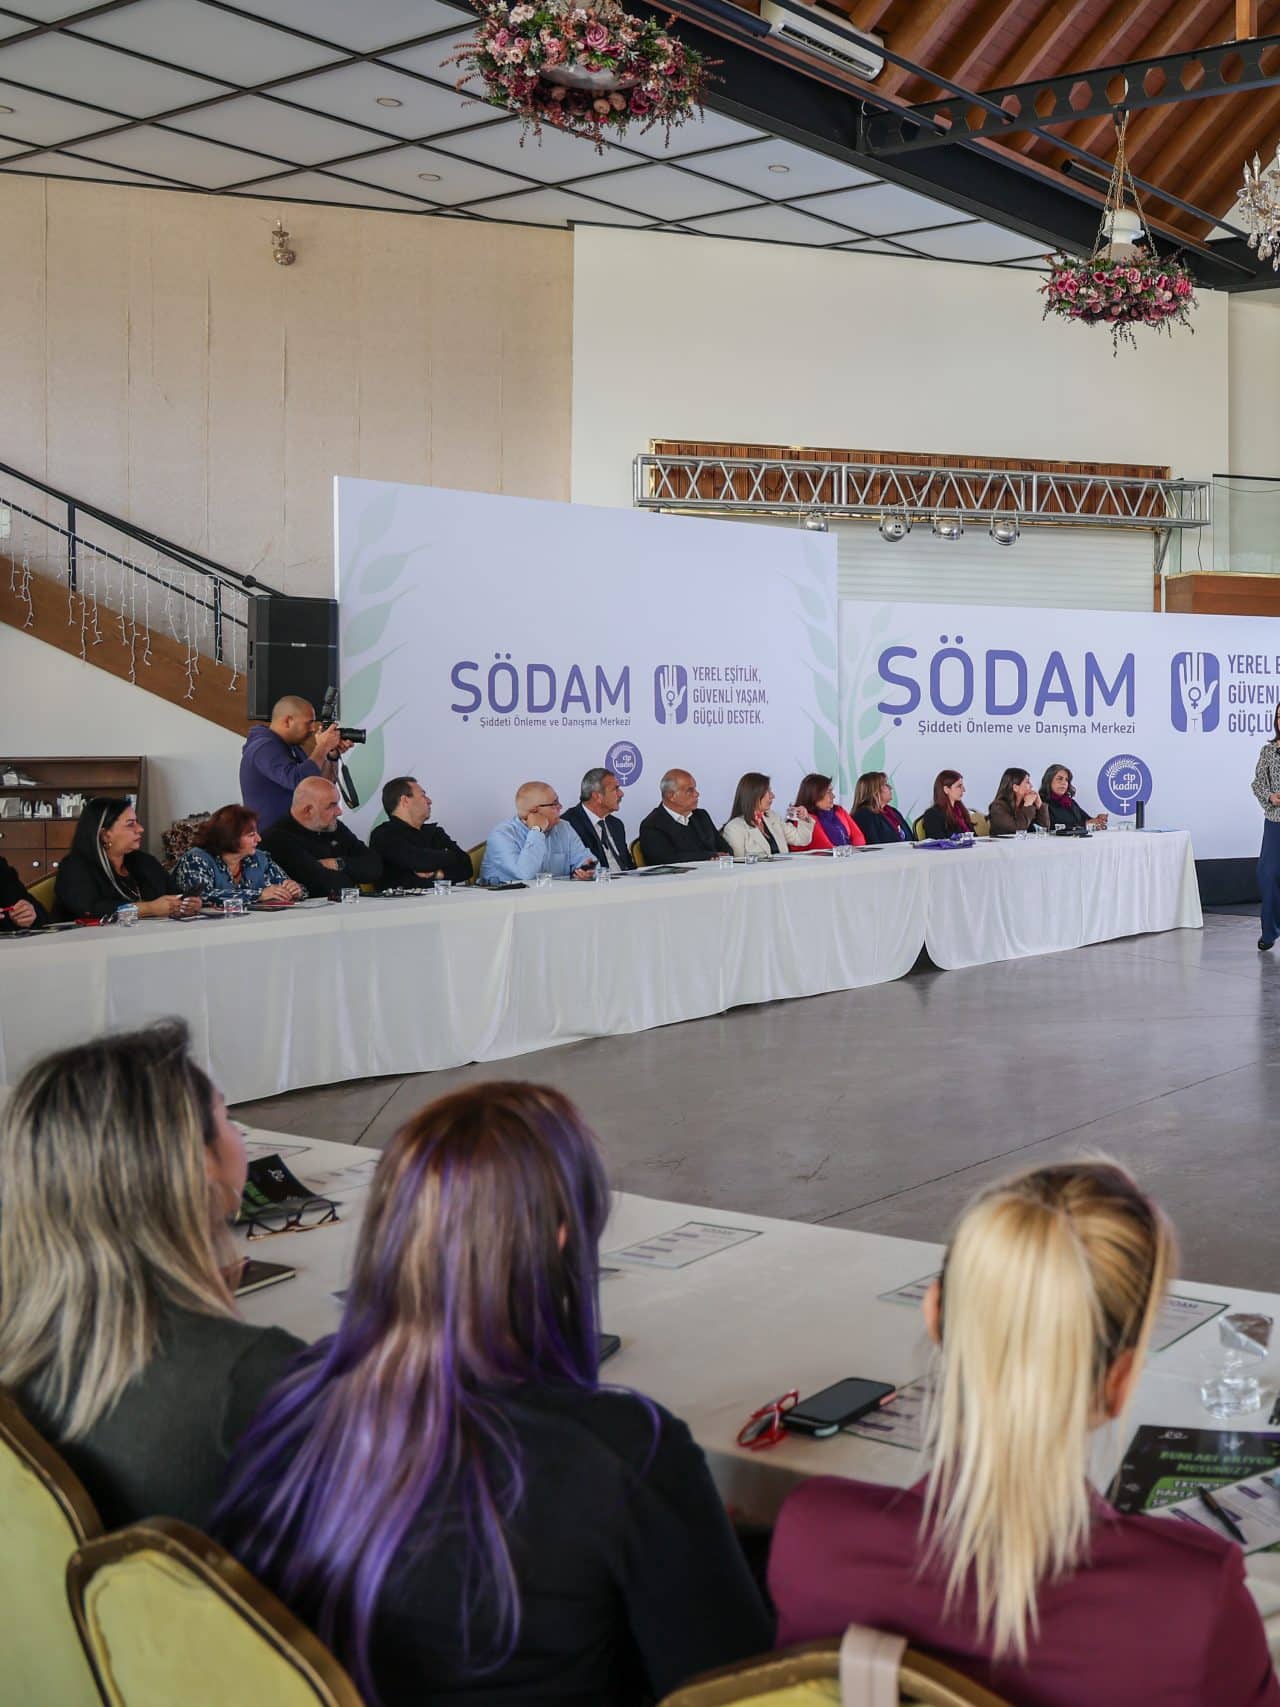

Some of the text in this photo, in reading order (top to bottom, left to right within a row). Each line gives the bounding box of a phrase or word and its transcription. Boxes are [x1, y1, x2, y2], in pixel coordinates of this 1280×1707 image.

[692, 664, 762, 684] YEREL EŞİTLİK,
[1227, 654, 1271, 674] YEREL
[693, 686, 769, 706] GÜVENLİ YAŞAM,
[480, 713, 631, 729] Şiddeti Önleme ve Danışma Merkezi
[693, 707, 765, 727] GÜÇLÜ DESTEK.
[918, 717, 1136, 736] Şiddeti Önleme ve Danışma Merkezi
[1228, 710, 1273, 736] GÜÇLÜ
